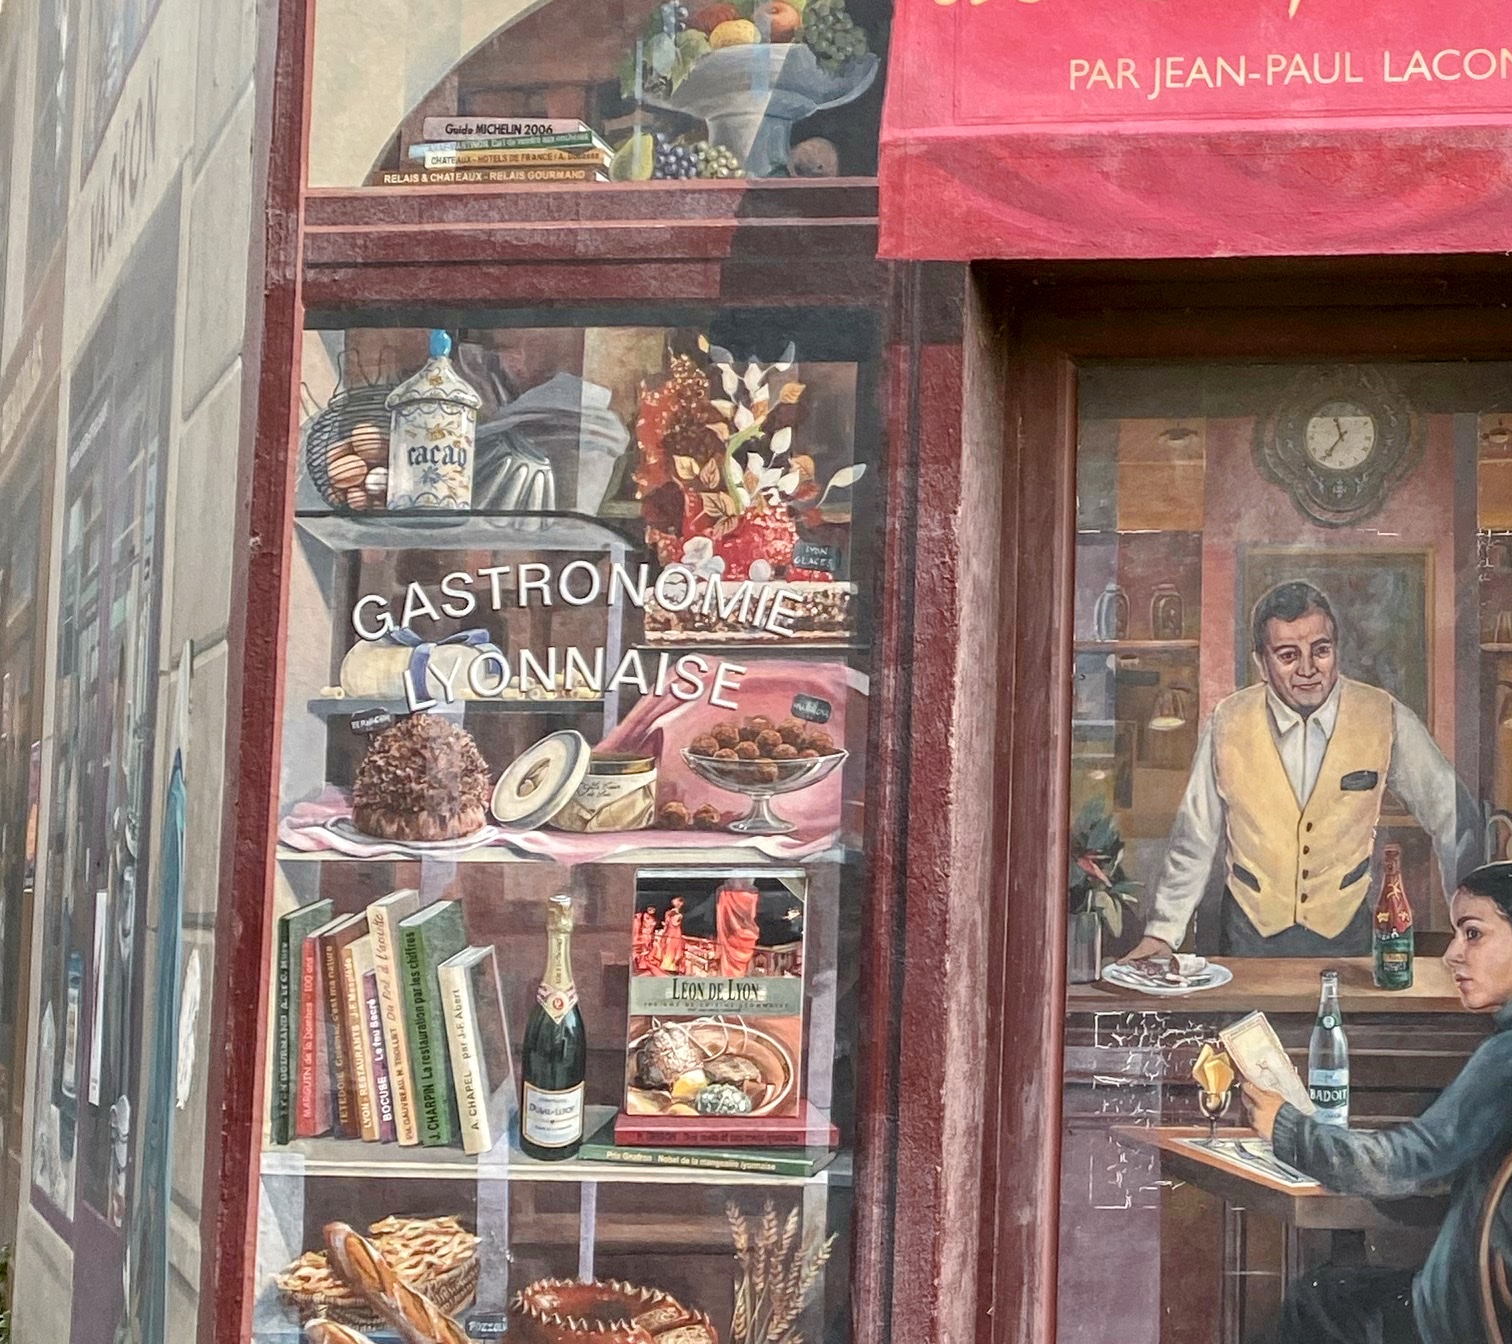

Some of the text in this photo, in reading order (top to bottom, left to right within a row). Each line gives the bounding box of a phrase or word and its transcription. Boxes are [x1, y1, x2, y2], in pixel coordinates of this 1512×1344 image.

[1069, 57, 1139, 90] PAR
[1148, 52, 1363, 99] JEAN-PAUL
[445, 123, 553, 135] Guide MICHELIN 2006
[521, 153, 552, 163] FRANCE
[384, 173, 420, 184] RELAIS
[421, 173, 429, 183] &
[430, 172, 482, 183] CHATEAUX
[490, 171, 526, 181] RELAIS
[527, 170, 585, 180] GOURMAND
[407, 444, 467, 468] cacao
[351, 559, 805, 641] GASTRONOMIE
[403, 646, 749, 713] LYONNAISE
[305, 975, 313, 992] 100
[329, 980, 338, 996] ma
[709, 982, 724, 1000] DE
[728, 979, 759, 1000] LYON
[372, 1030, 383, 1048] feu
[404, 932, 441, 1140] J. CHARPIN La restauration par les chiffres
[374, 1049, 384, 1061] Le
[460, 1042, 471, 1059] par
[378, 1076, 393, 1122] BOCUSE
[464, 1071, 478, 1117] CHAPEL
[1310, 1088, 1347, 1102] BADOIT
[362, 1102, 372, 1128] LYON
[470, 1119, 480, 1130] A.
[681, 1156, 690, 1164] de
